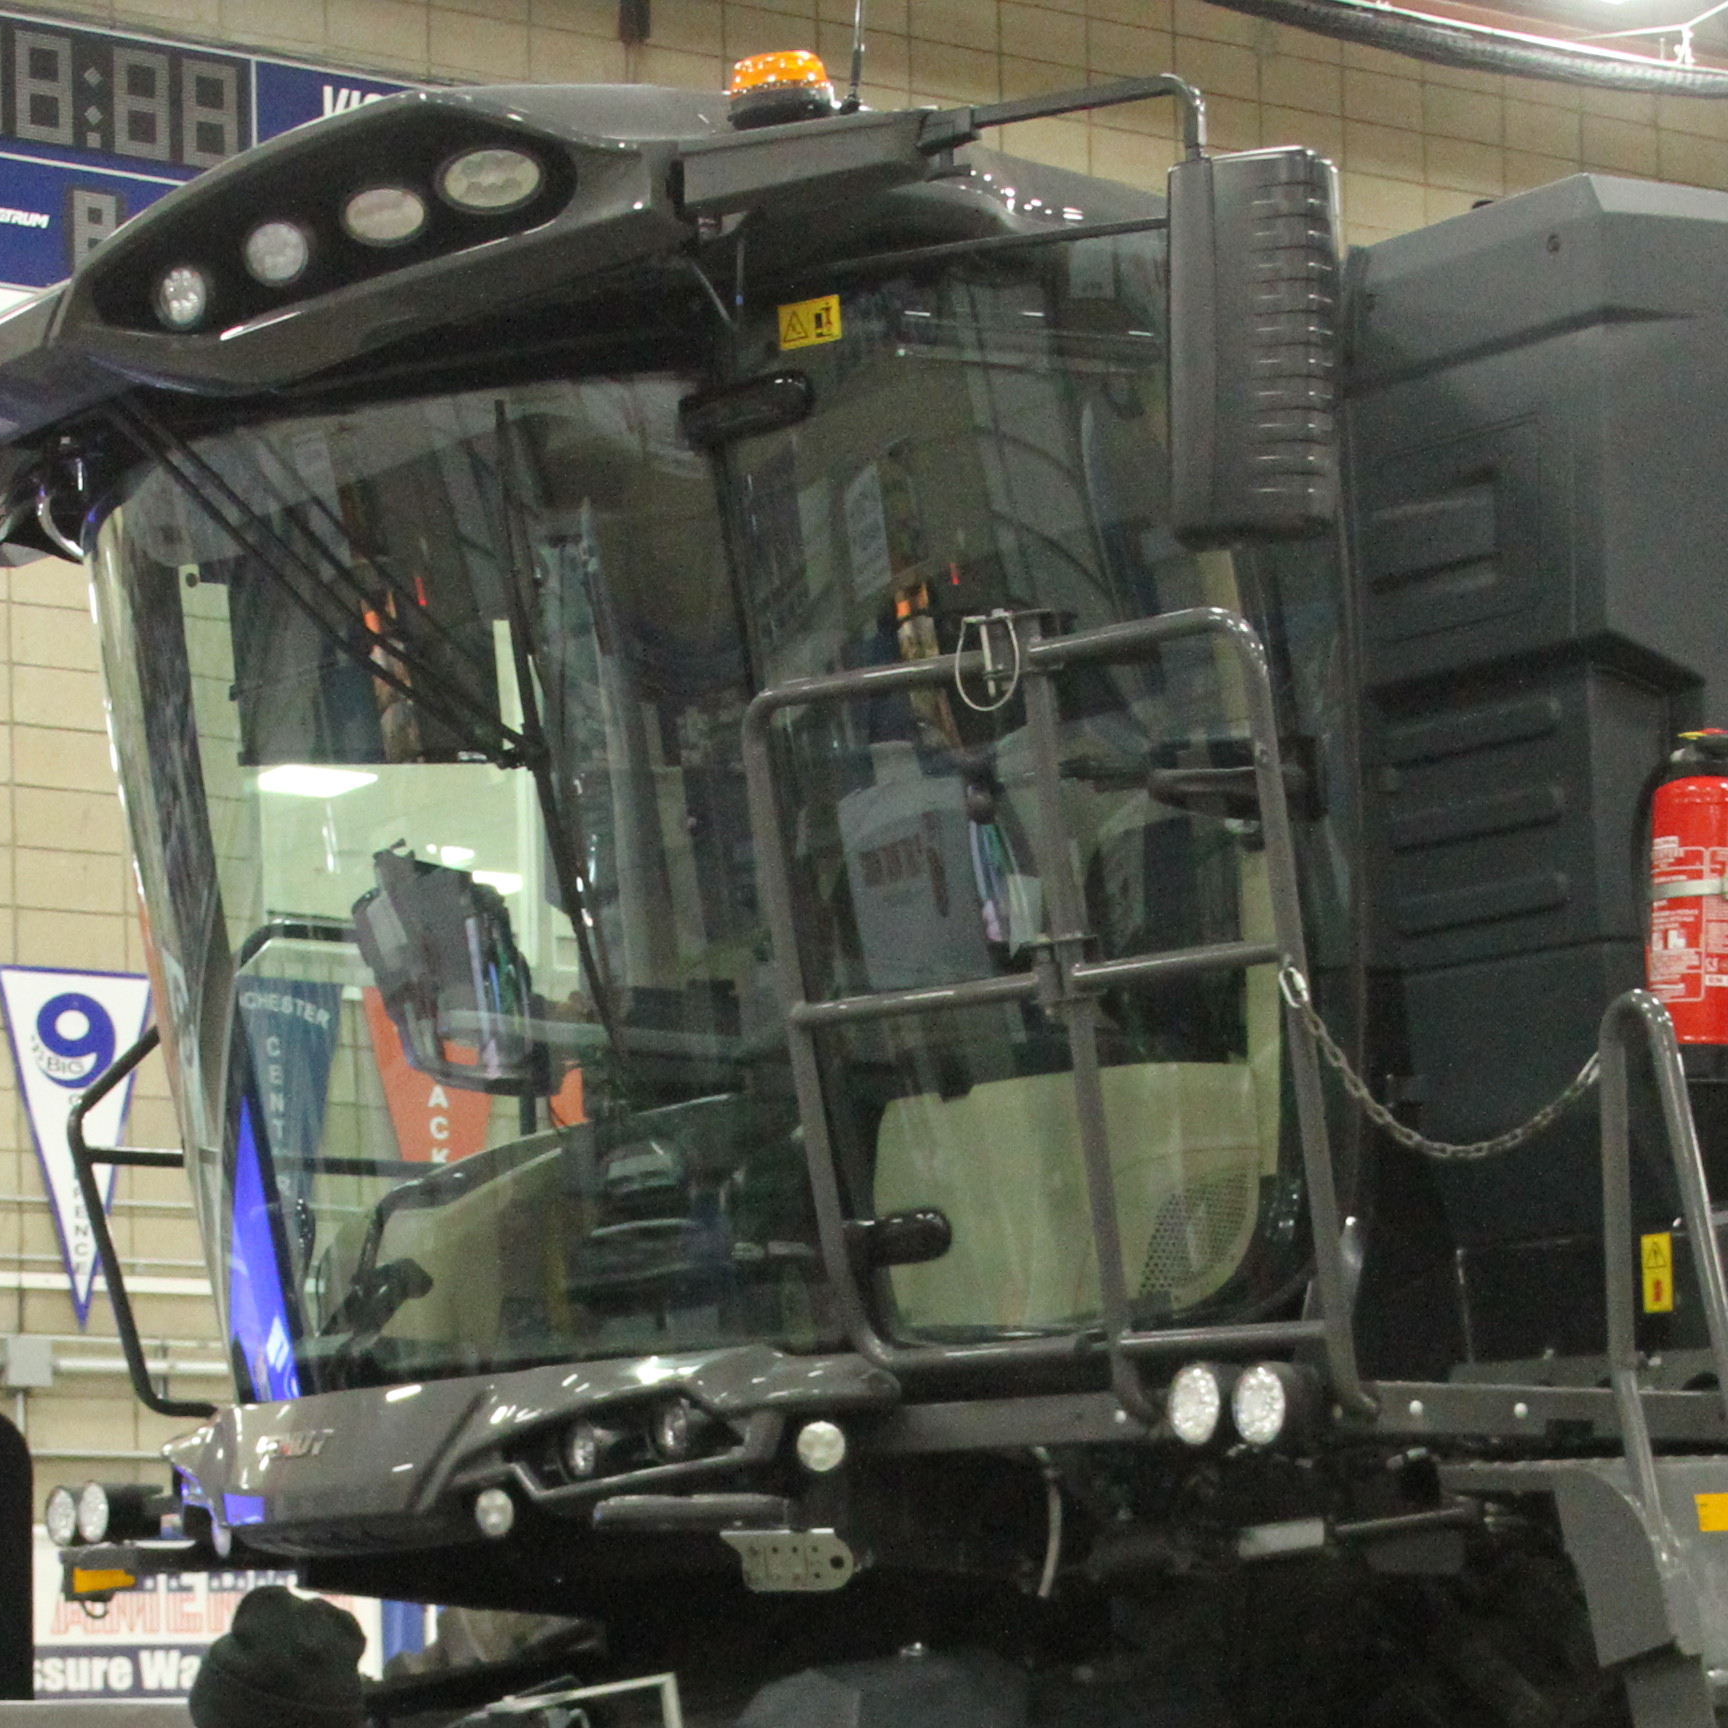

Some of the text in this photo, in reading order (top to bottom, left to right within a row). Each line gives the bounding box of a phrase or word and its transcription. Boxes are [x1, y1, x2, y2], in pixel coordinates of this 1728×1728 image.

[36, 992, 116, 1089] 9
[46, 1057, 85, 1075] BIG
[33, 1650, 204, 1692] ssure Wa
